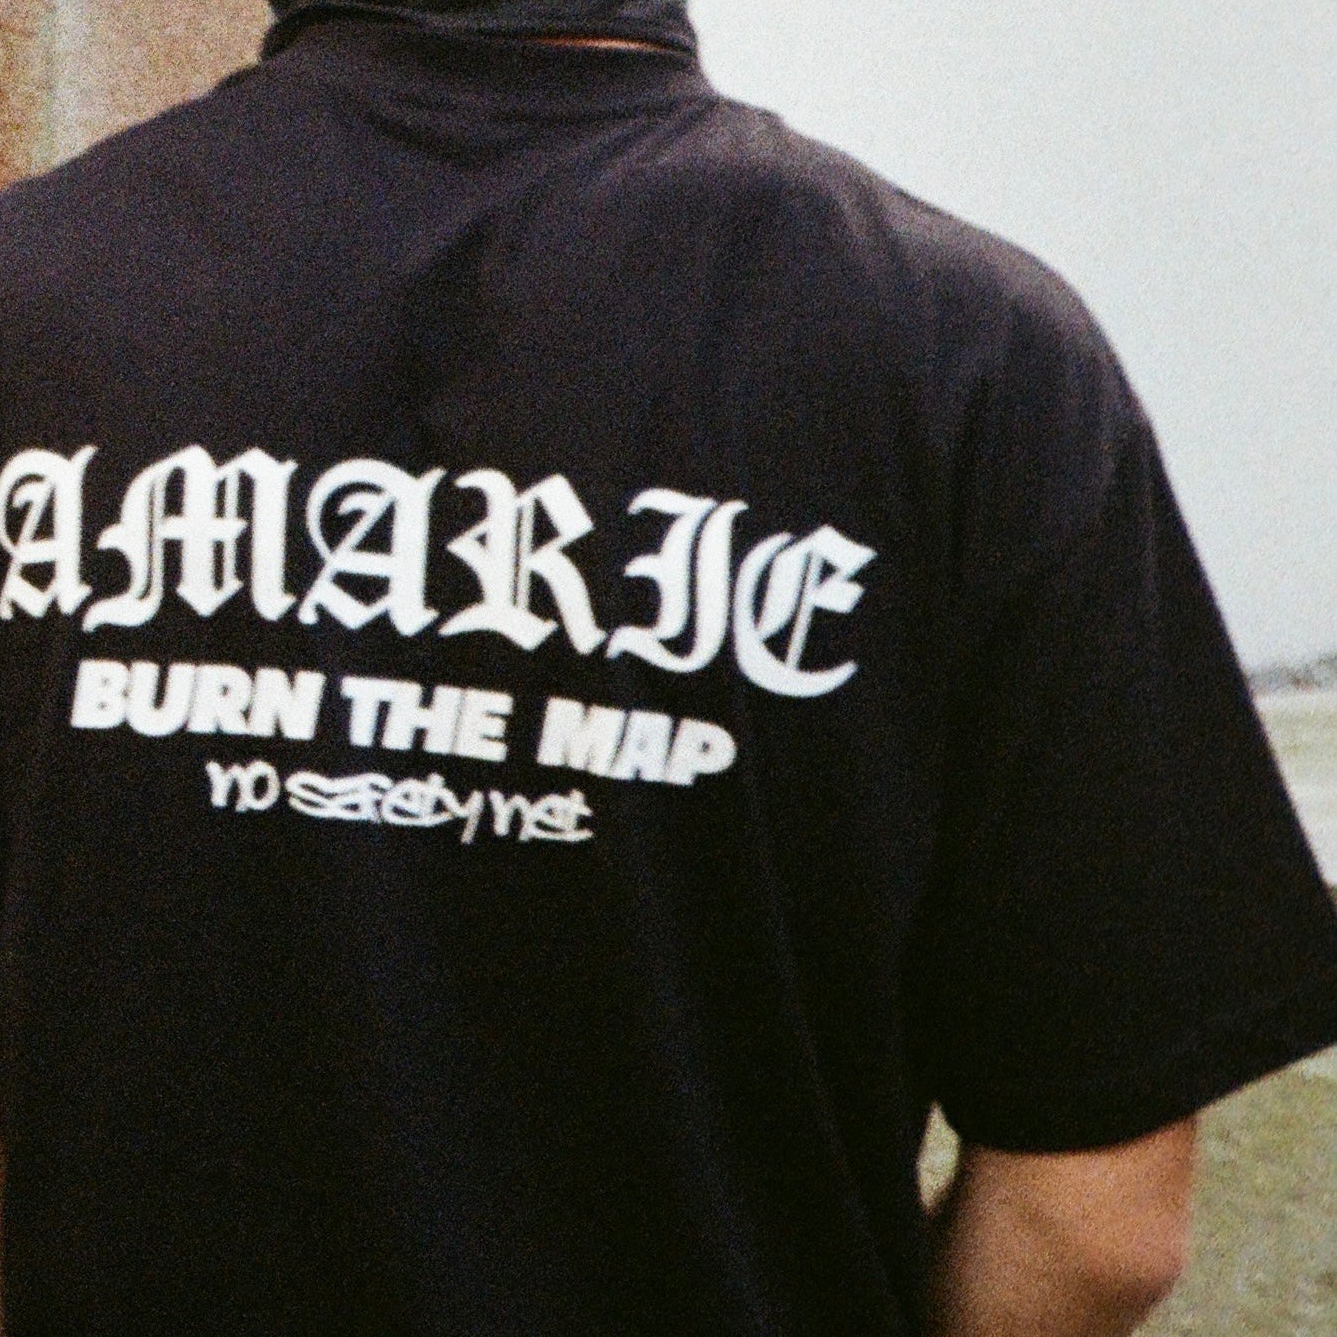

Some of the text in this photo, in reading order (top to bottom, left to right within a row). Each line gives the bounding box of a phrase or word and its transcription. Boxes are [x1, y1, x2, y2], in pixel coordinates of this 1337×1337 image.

[70, 658, 737, 786] BURN THE MAP
